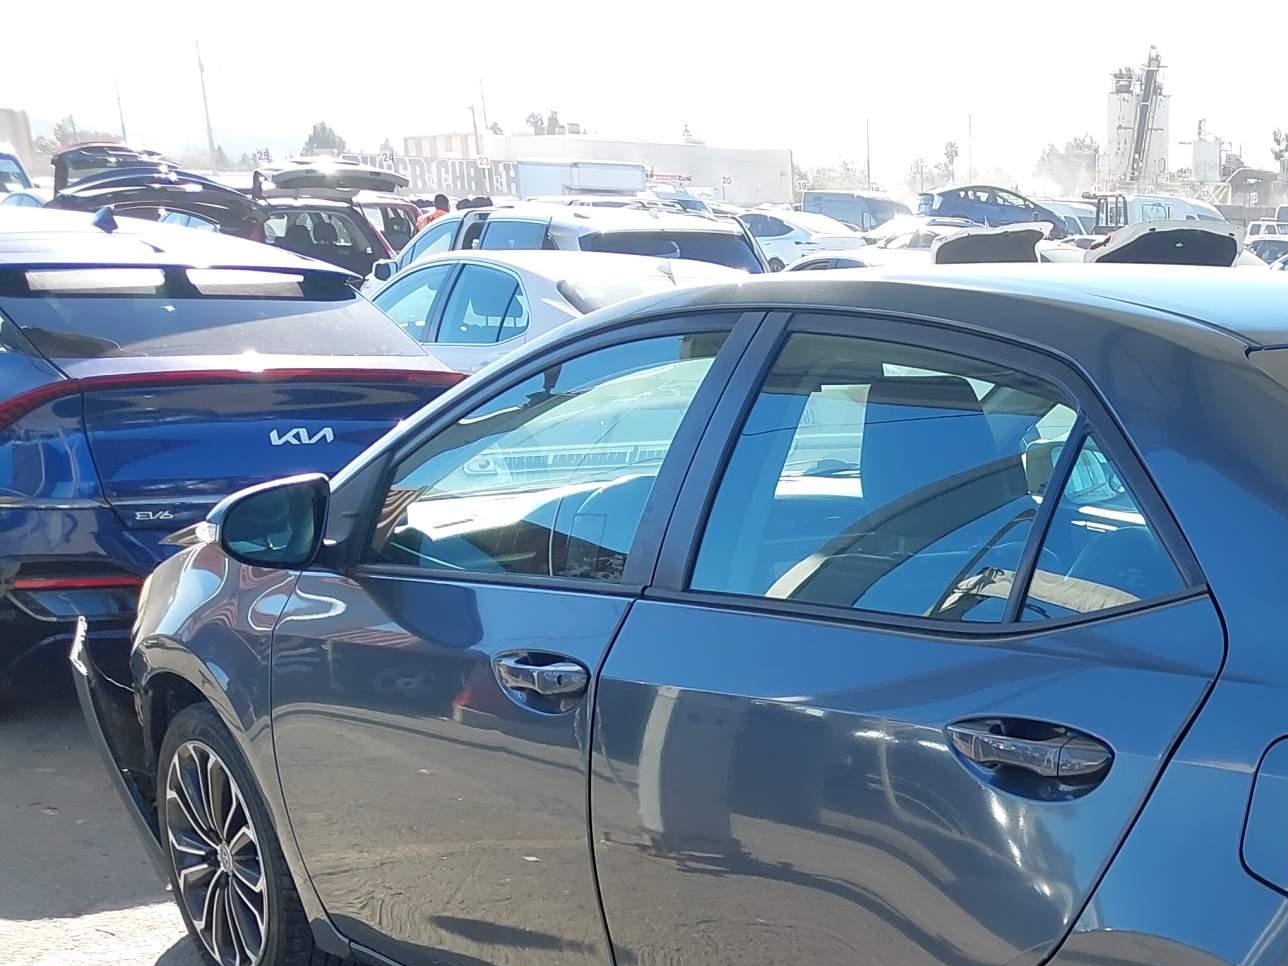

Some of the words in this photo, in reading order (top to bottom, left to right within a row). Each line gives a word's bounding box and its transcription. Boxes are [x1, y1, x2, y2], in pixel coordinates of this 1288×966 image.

[257, 151, 270, 161] 25
[382, 152, 393, 162] 24
[478, 157, 490, 166] 23
[722, 176, 732, 185] 20
[269, 427, 334, 446] KIA
[135, 511, 175, 520] EV6
